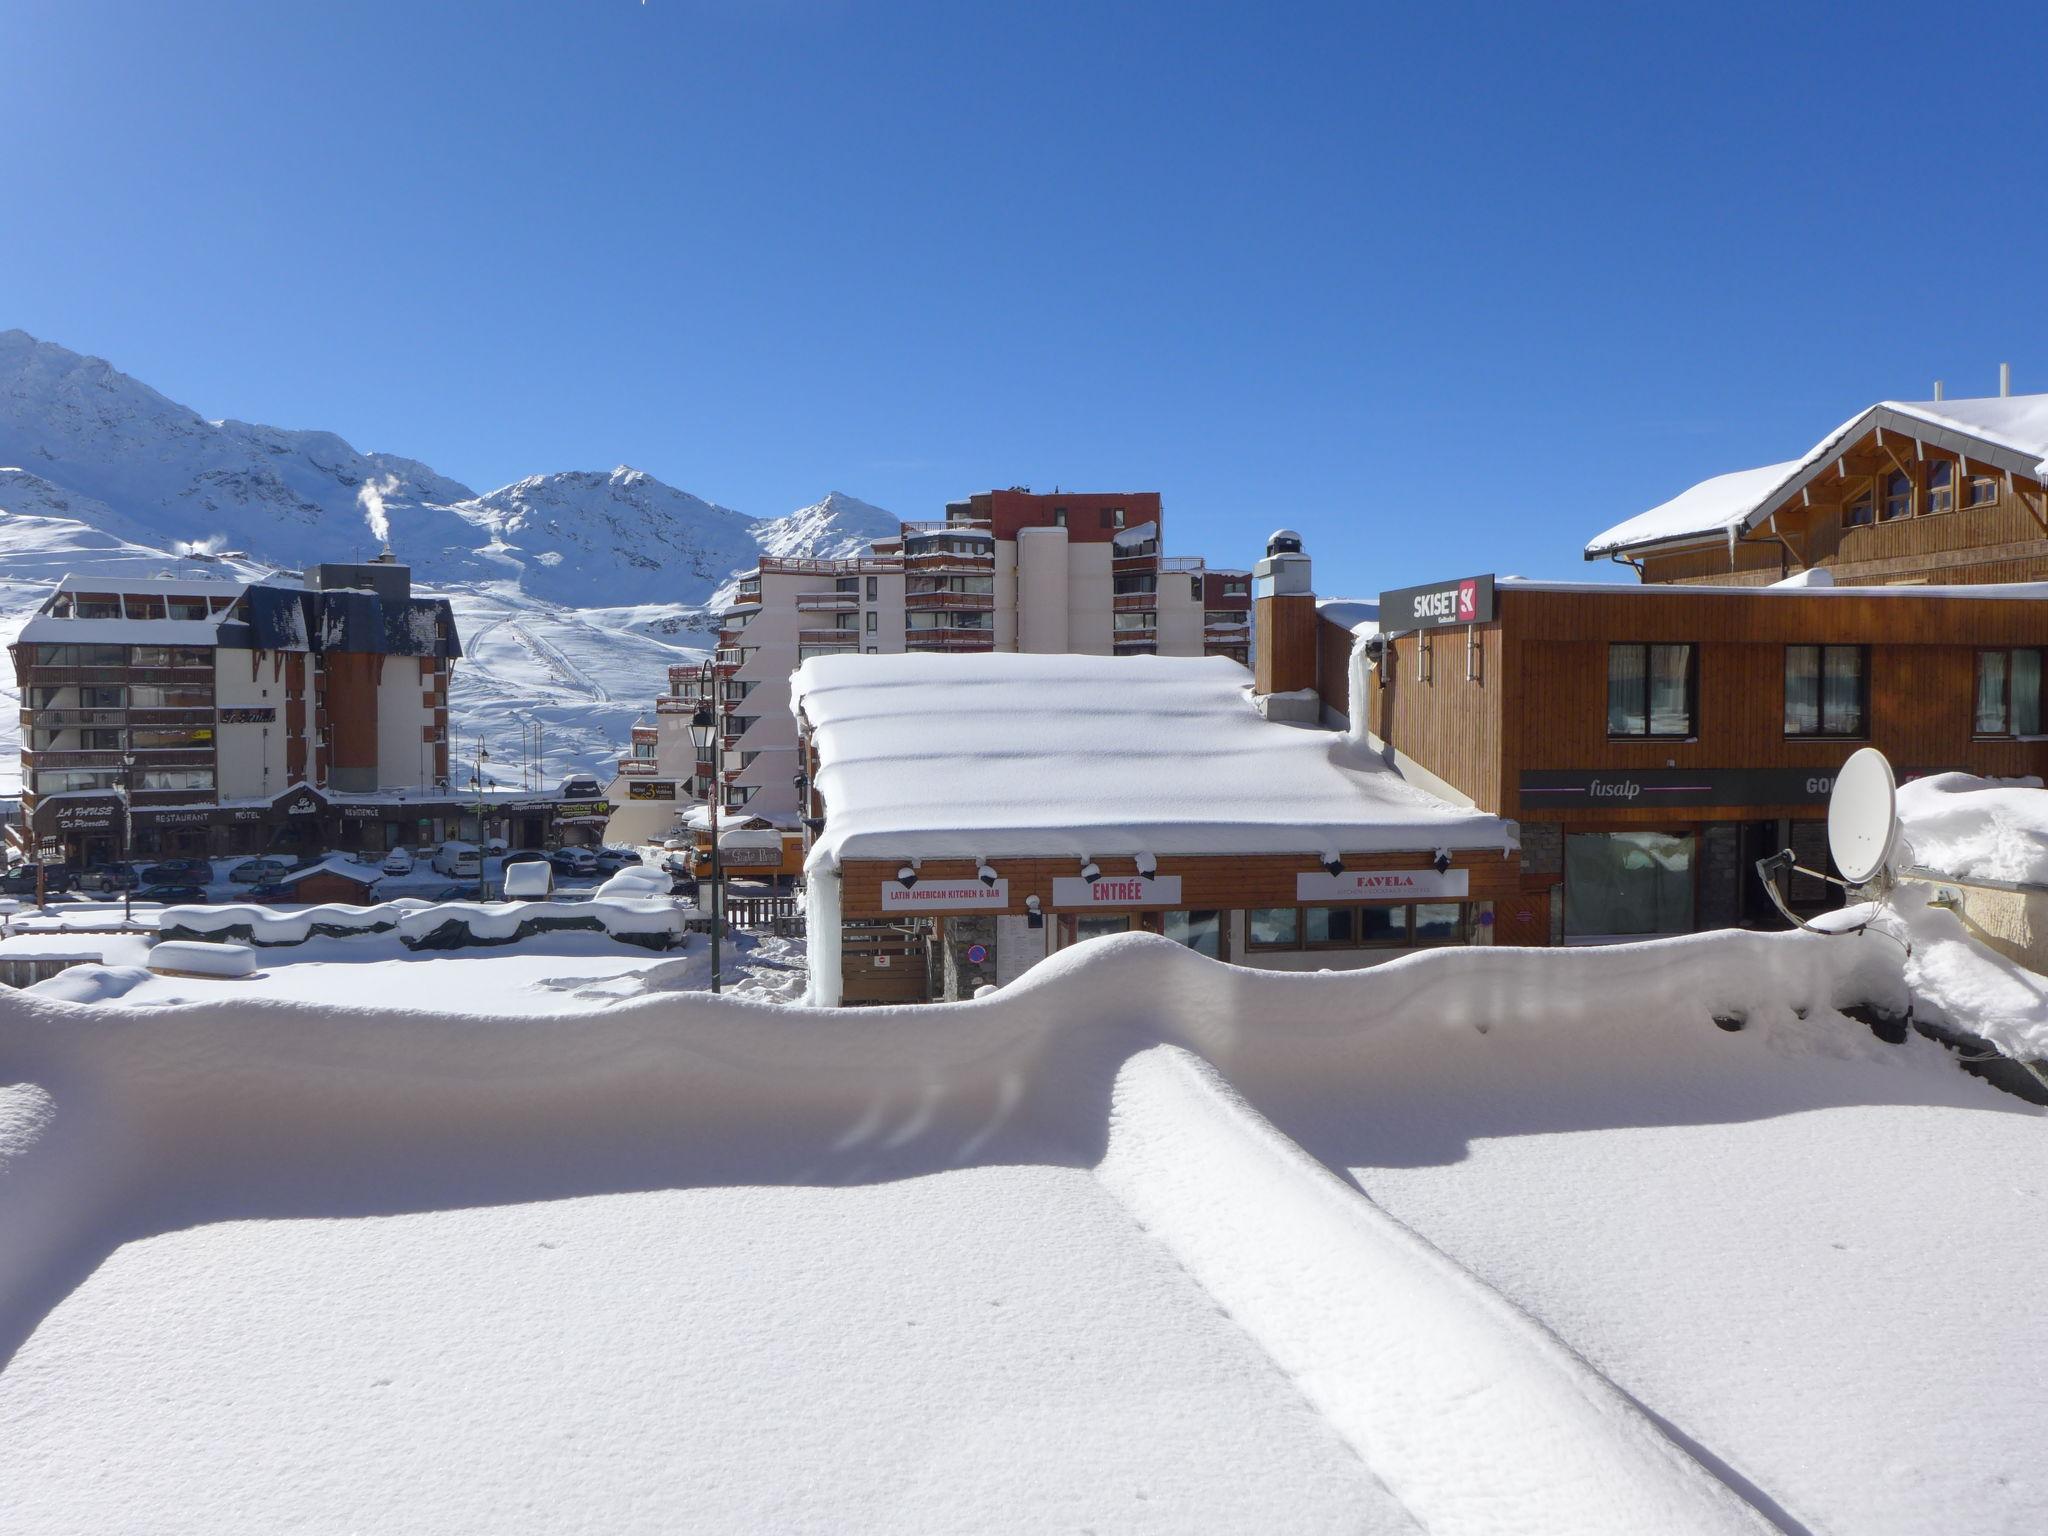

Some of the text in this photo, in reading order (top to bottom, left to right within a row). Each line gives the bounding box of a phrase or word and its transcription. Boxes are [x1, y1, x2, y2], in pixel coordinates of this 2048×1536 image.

[1413, 590, 1458, 618] SKISET
[645, 783, 656, 799] 3
[1590, 779, 1640, 800] fusalp
[56, 806, 115, 818] LA PAUSE
[511, 803, 553, 811] Supermarket
[155, 813, 209, 823] RESTAURANT
[1357, 876, 1414, 888] FAVELA
[890, 889, 1000, 900] LATIN AMERICAN KITCHEN & BAR
[1093, 879, 1142, 900] ENTRÉE
